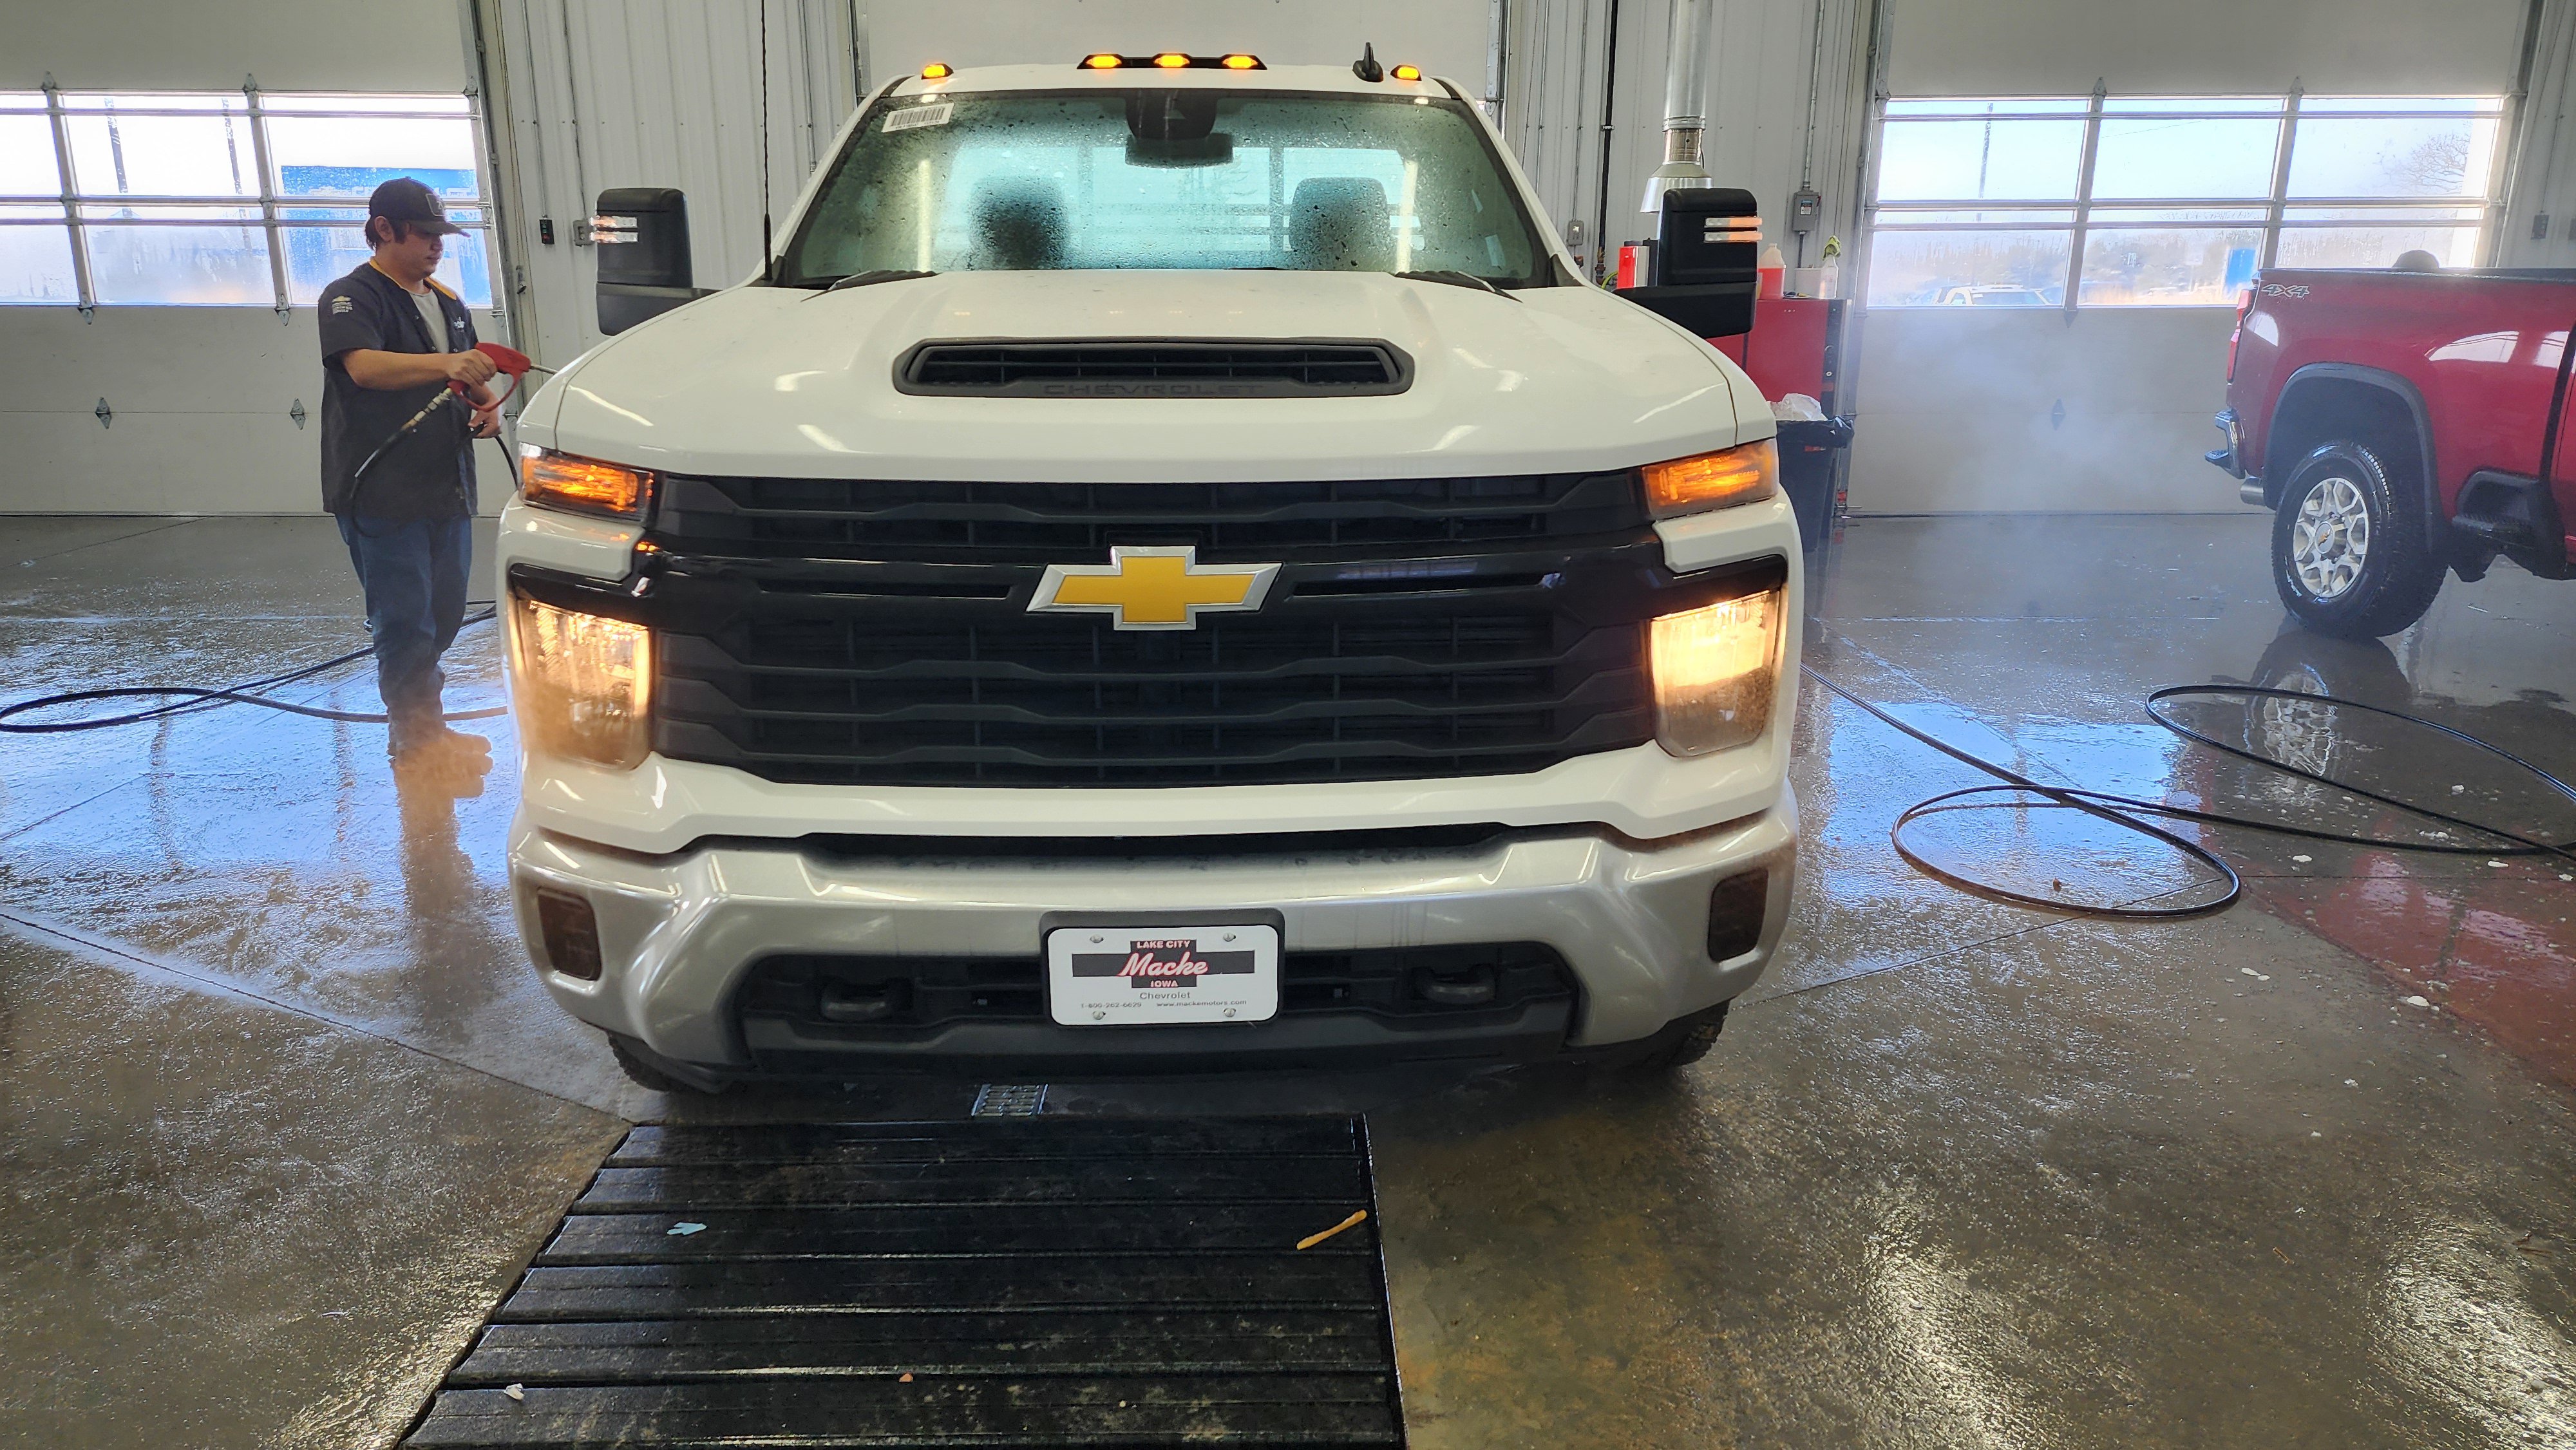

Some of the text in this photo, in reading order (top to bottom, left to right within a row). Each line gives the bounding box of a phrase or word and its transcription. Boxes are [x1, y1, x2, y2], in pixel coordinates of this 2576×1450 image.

[1043, 384, 1264, 395] CHEVROLET
[1136, 940, 1191, 949] LAKE CITY
[1116, 950, 1209, 977] Macke
